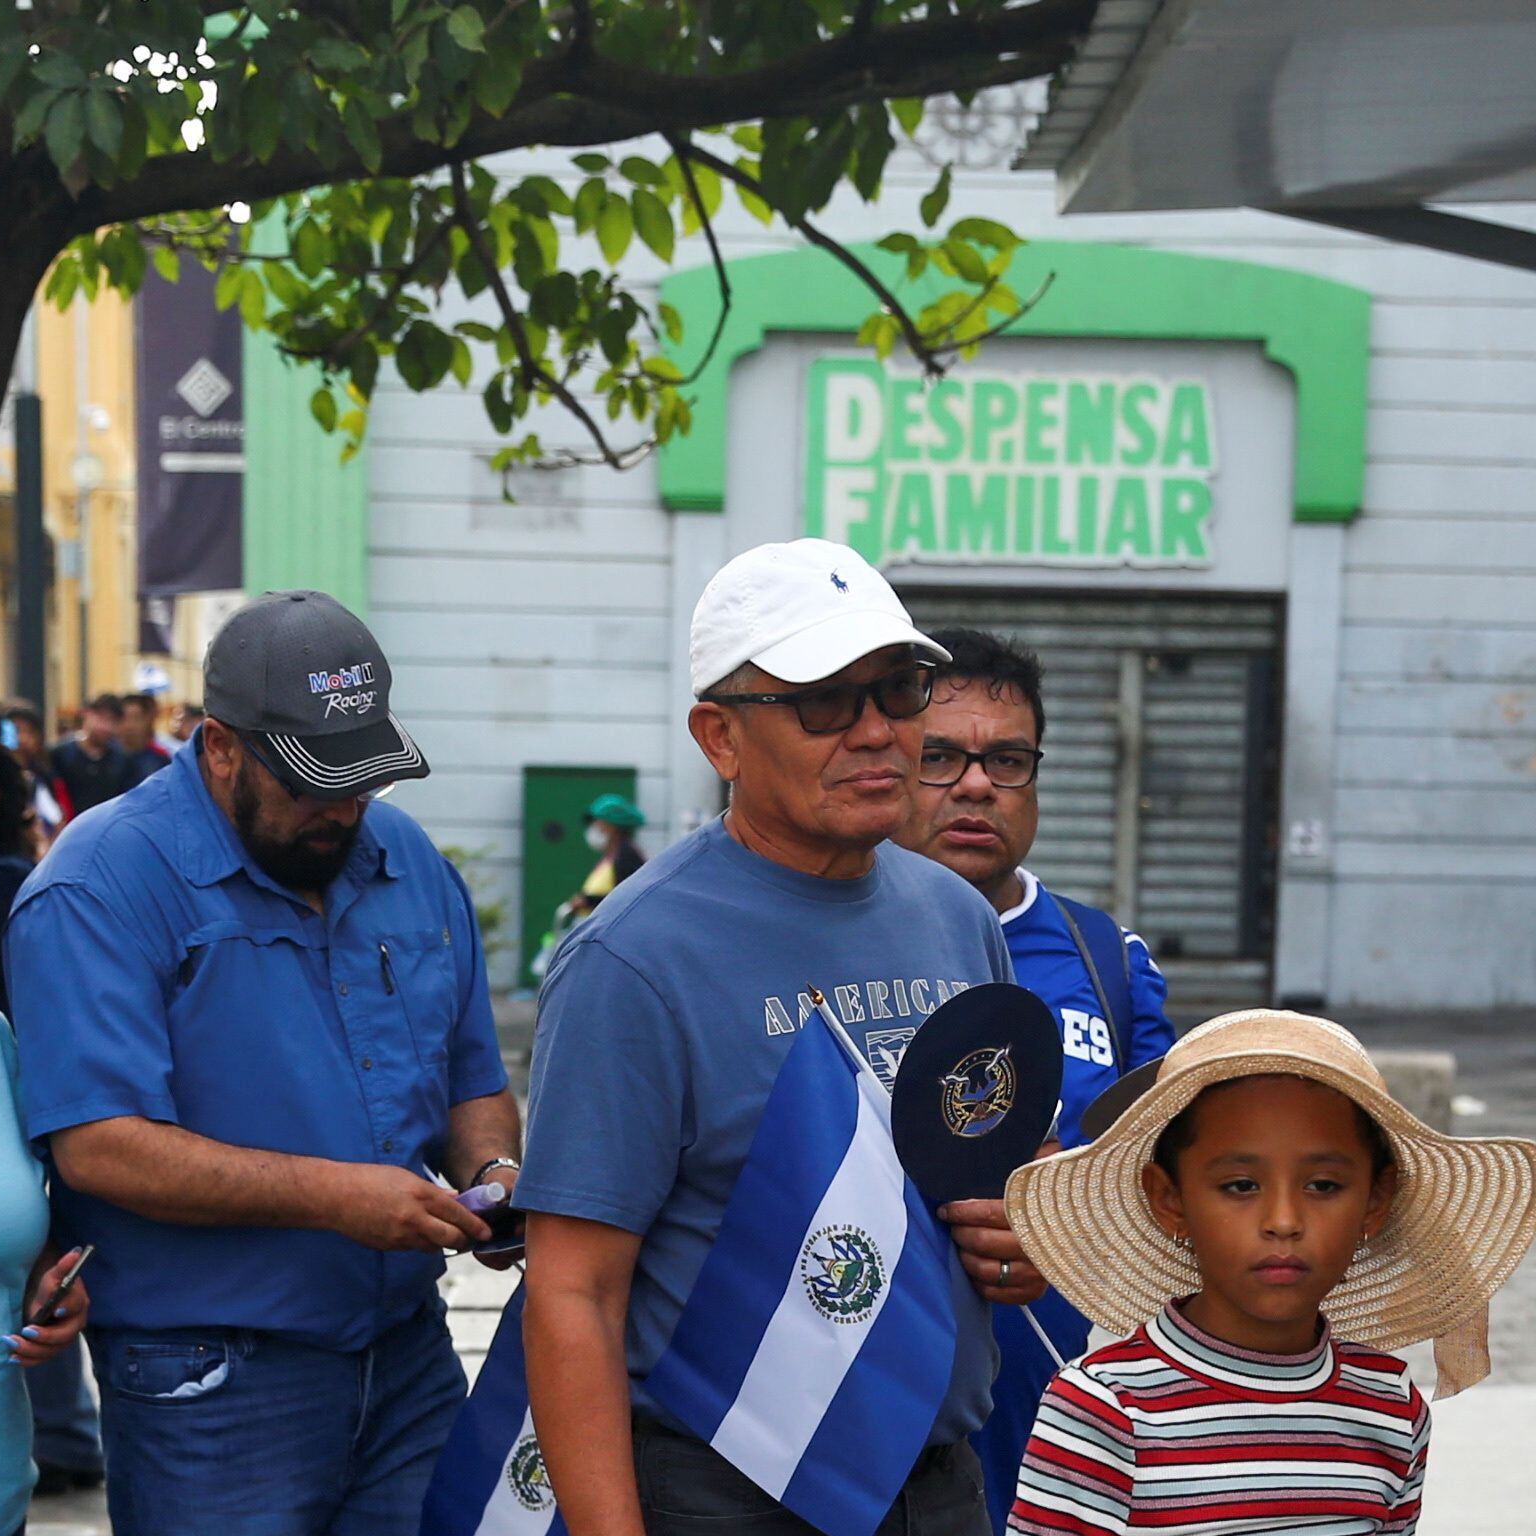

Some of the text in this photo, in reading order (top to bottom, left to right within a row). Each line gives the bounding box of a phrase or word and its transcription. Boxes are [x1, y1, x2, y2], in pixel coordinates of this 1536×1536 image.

[824, 374, 1212, 467] DESPENSA
[823, 467, 1213, 558] FAMILIAR
[308, 664, 363, 694] Mobil
[320, 690, 377, 719] Racing
[765, 979, 970, 1036] AERICA
[1060, 1008, 1114, 1067] ES
